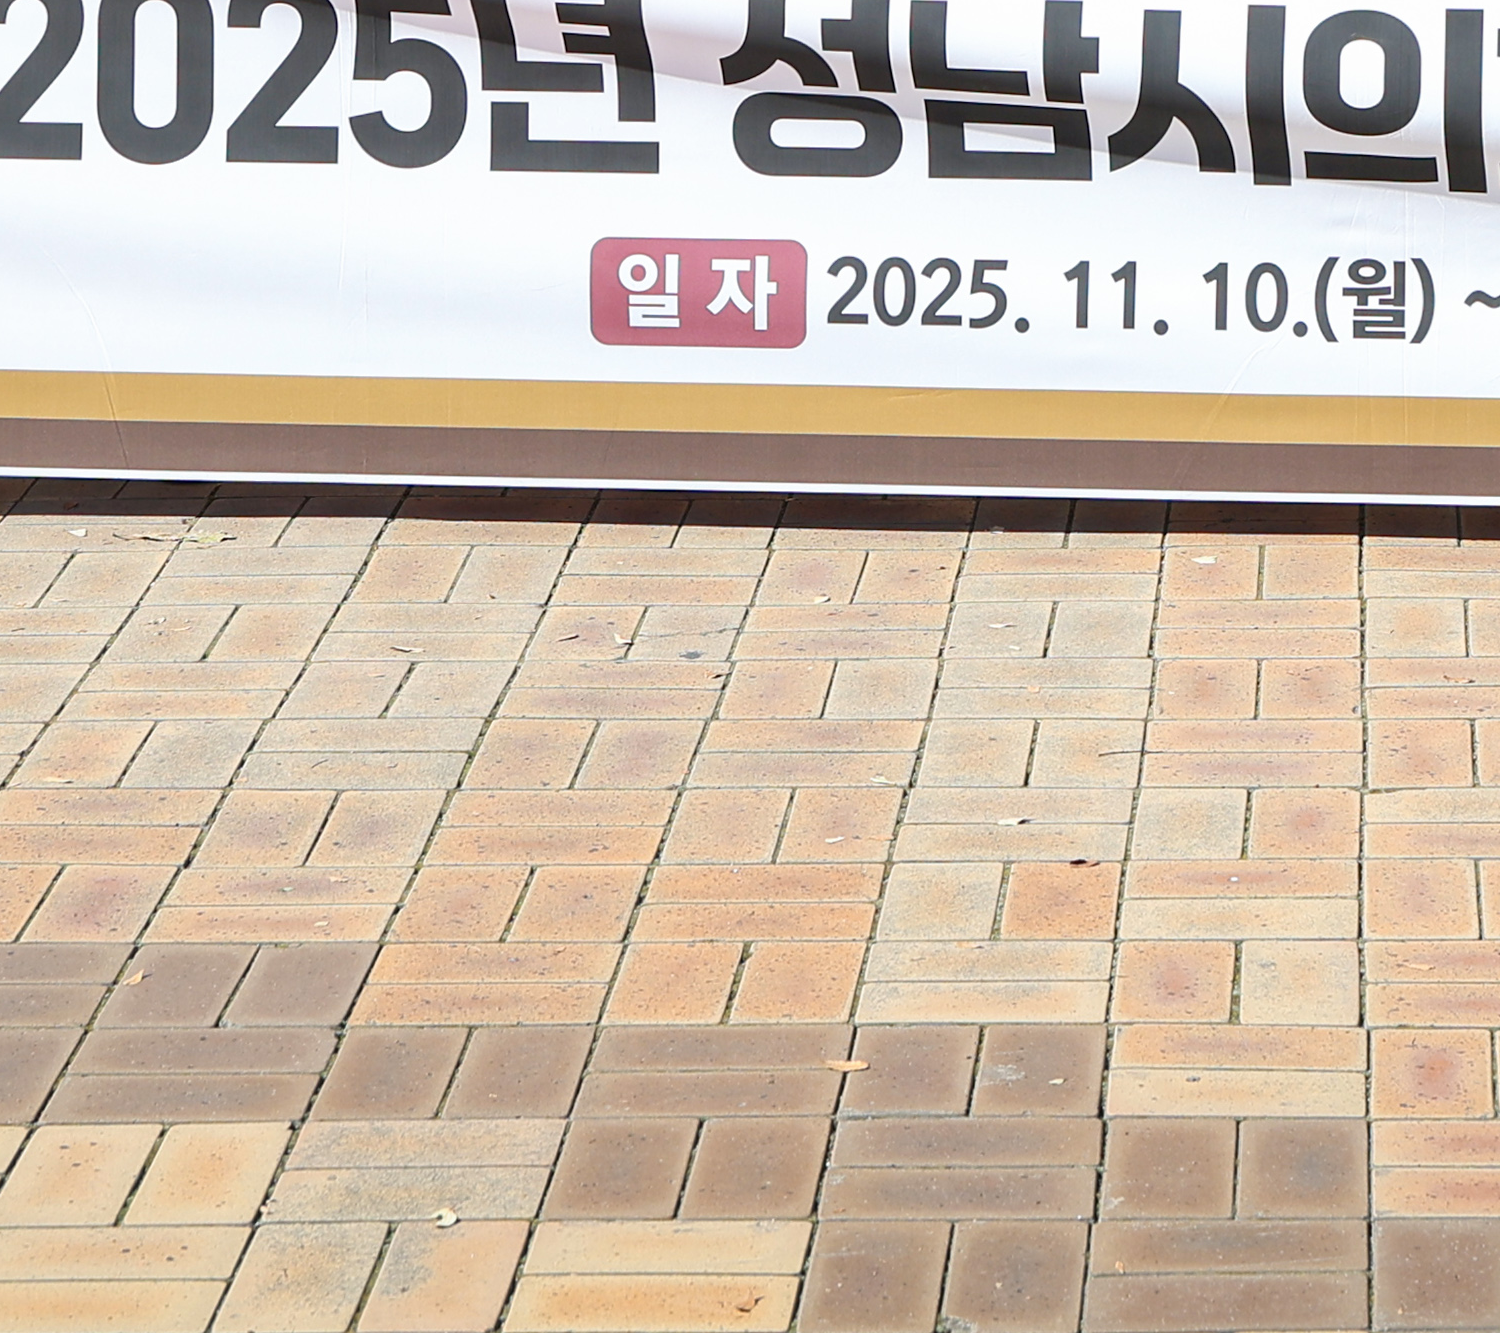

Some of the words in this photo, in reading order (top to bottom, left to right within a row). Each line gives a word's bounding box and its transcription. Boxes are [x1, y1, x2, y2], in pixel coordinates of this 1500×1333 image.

[828, 257, 1029, 333] 2025.
[1065, 261, 1168, 335] 11.
[1203, 257, 1434, 343] 10.(월)
